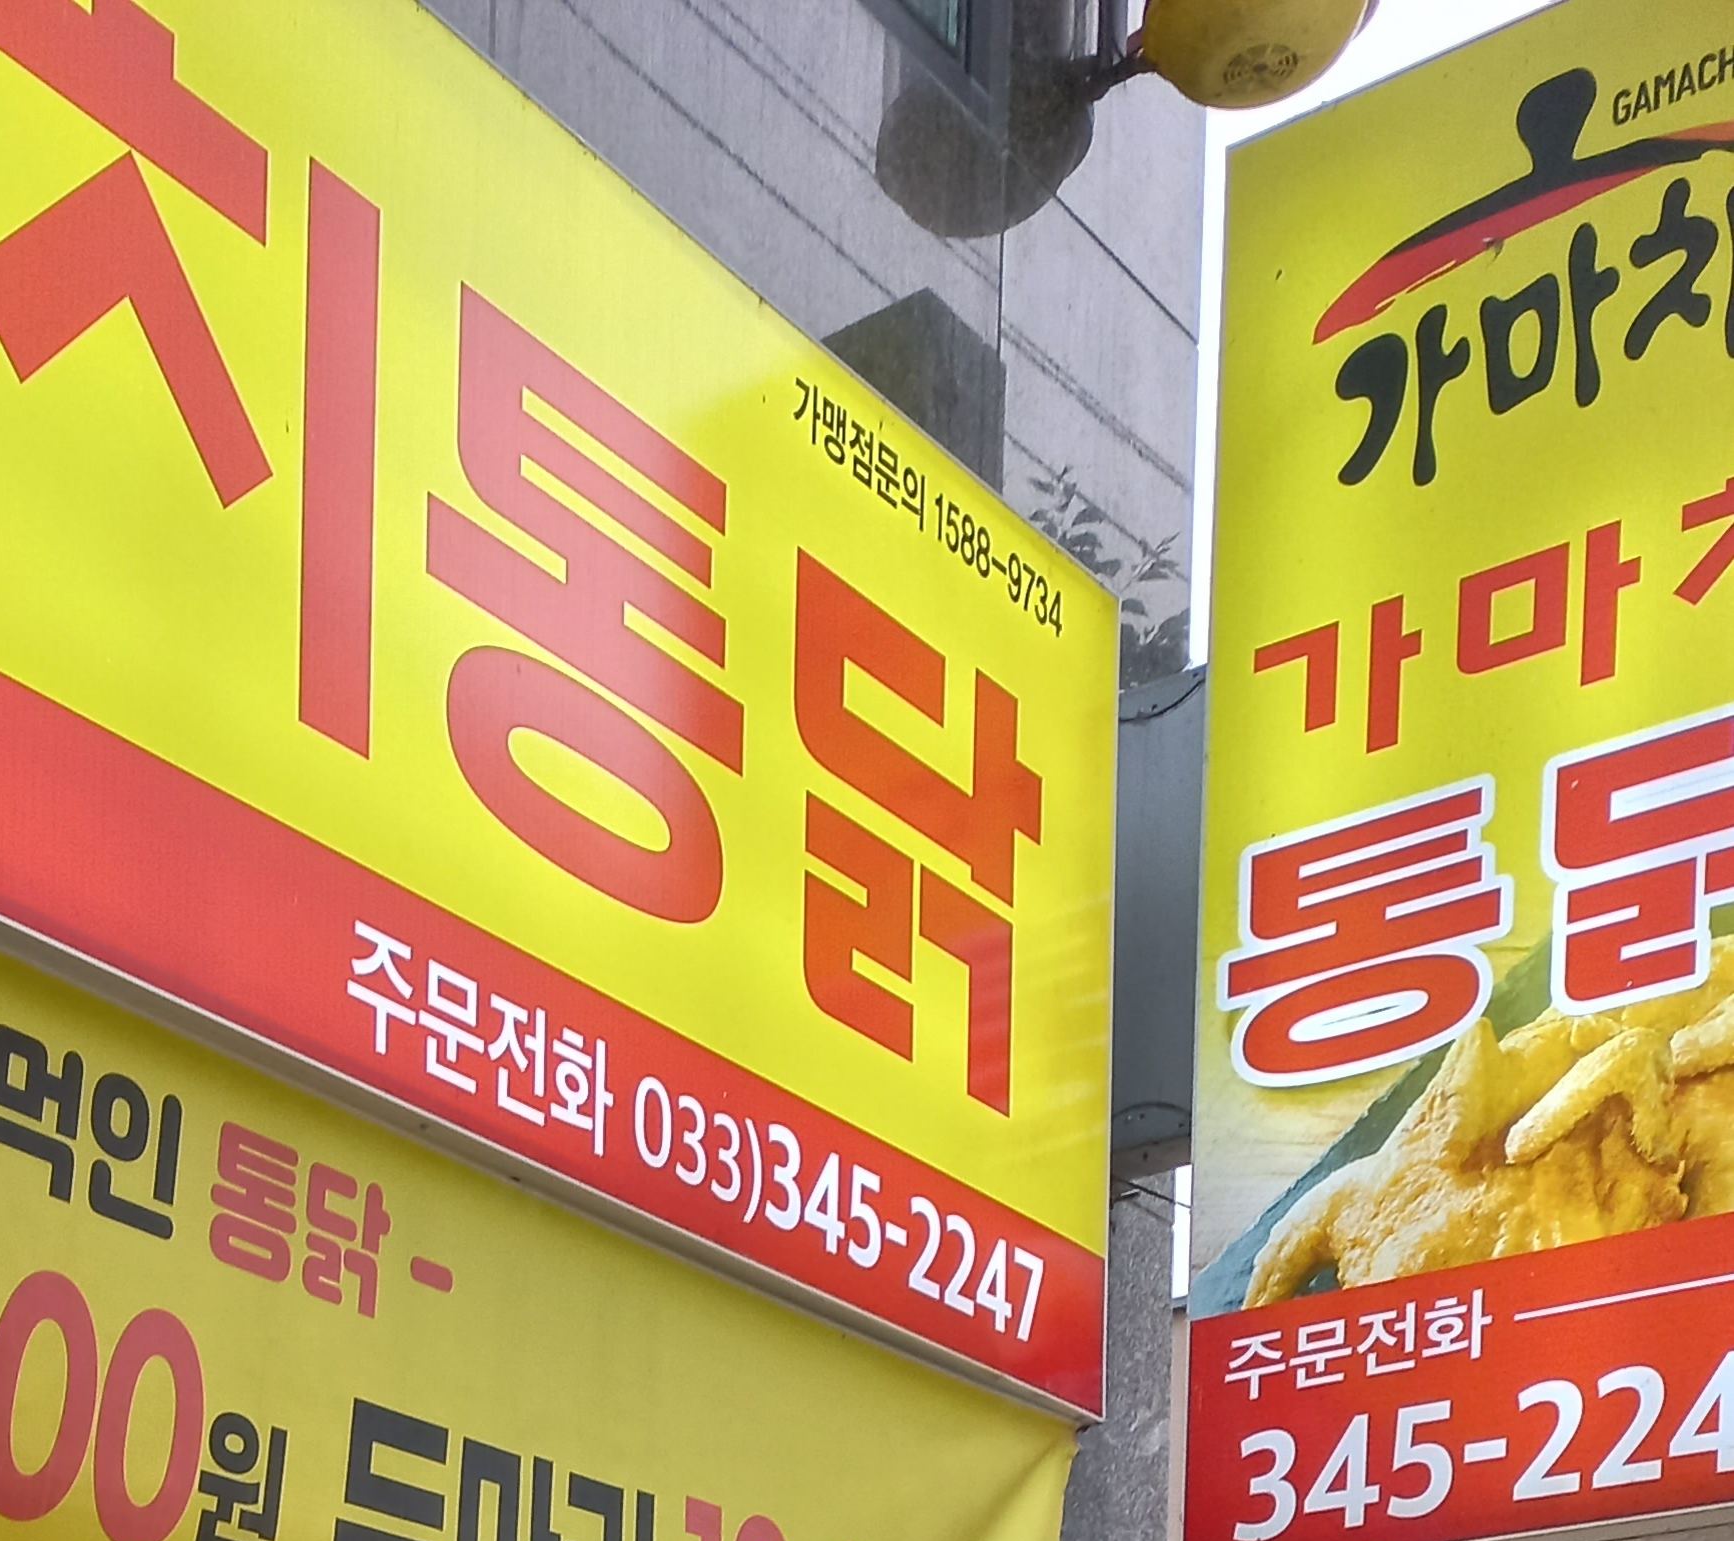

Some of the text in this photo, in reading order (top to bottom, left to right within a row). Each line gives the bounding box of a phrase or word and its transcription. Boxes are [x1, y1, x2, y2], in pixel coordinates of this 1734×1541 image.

[793, 377, 1063, 638] 가맹점문의 1588-9734
[208, 1120, 391, 1319] 통닭
[346, 920, 1046, 1343] 주문전화 033)345-2247
[1224, 1288, 1494, 1402] 주문전화
